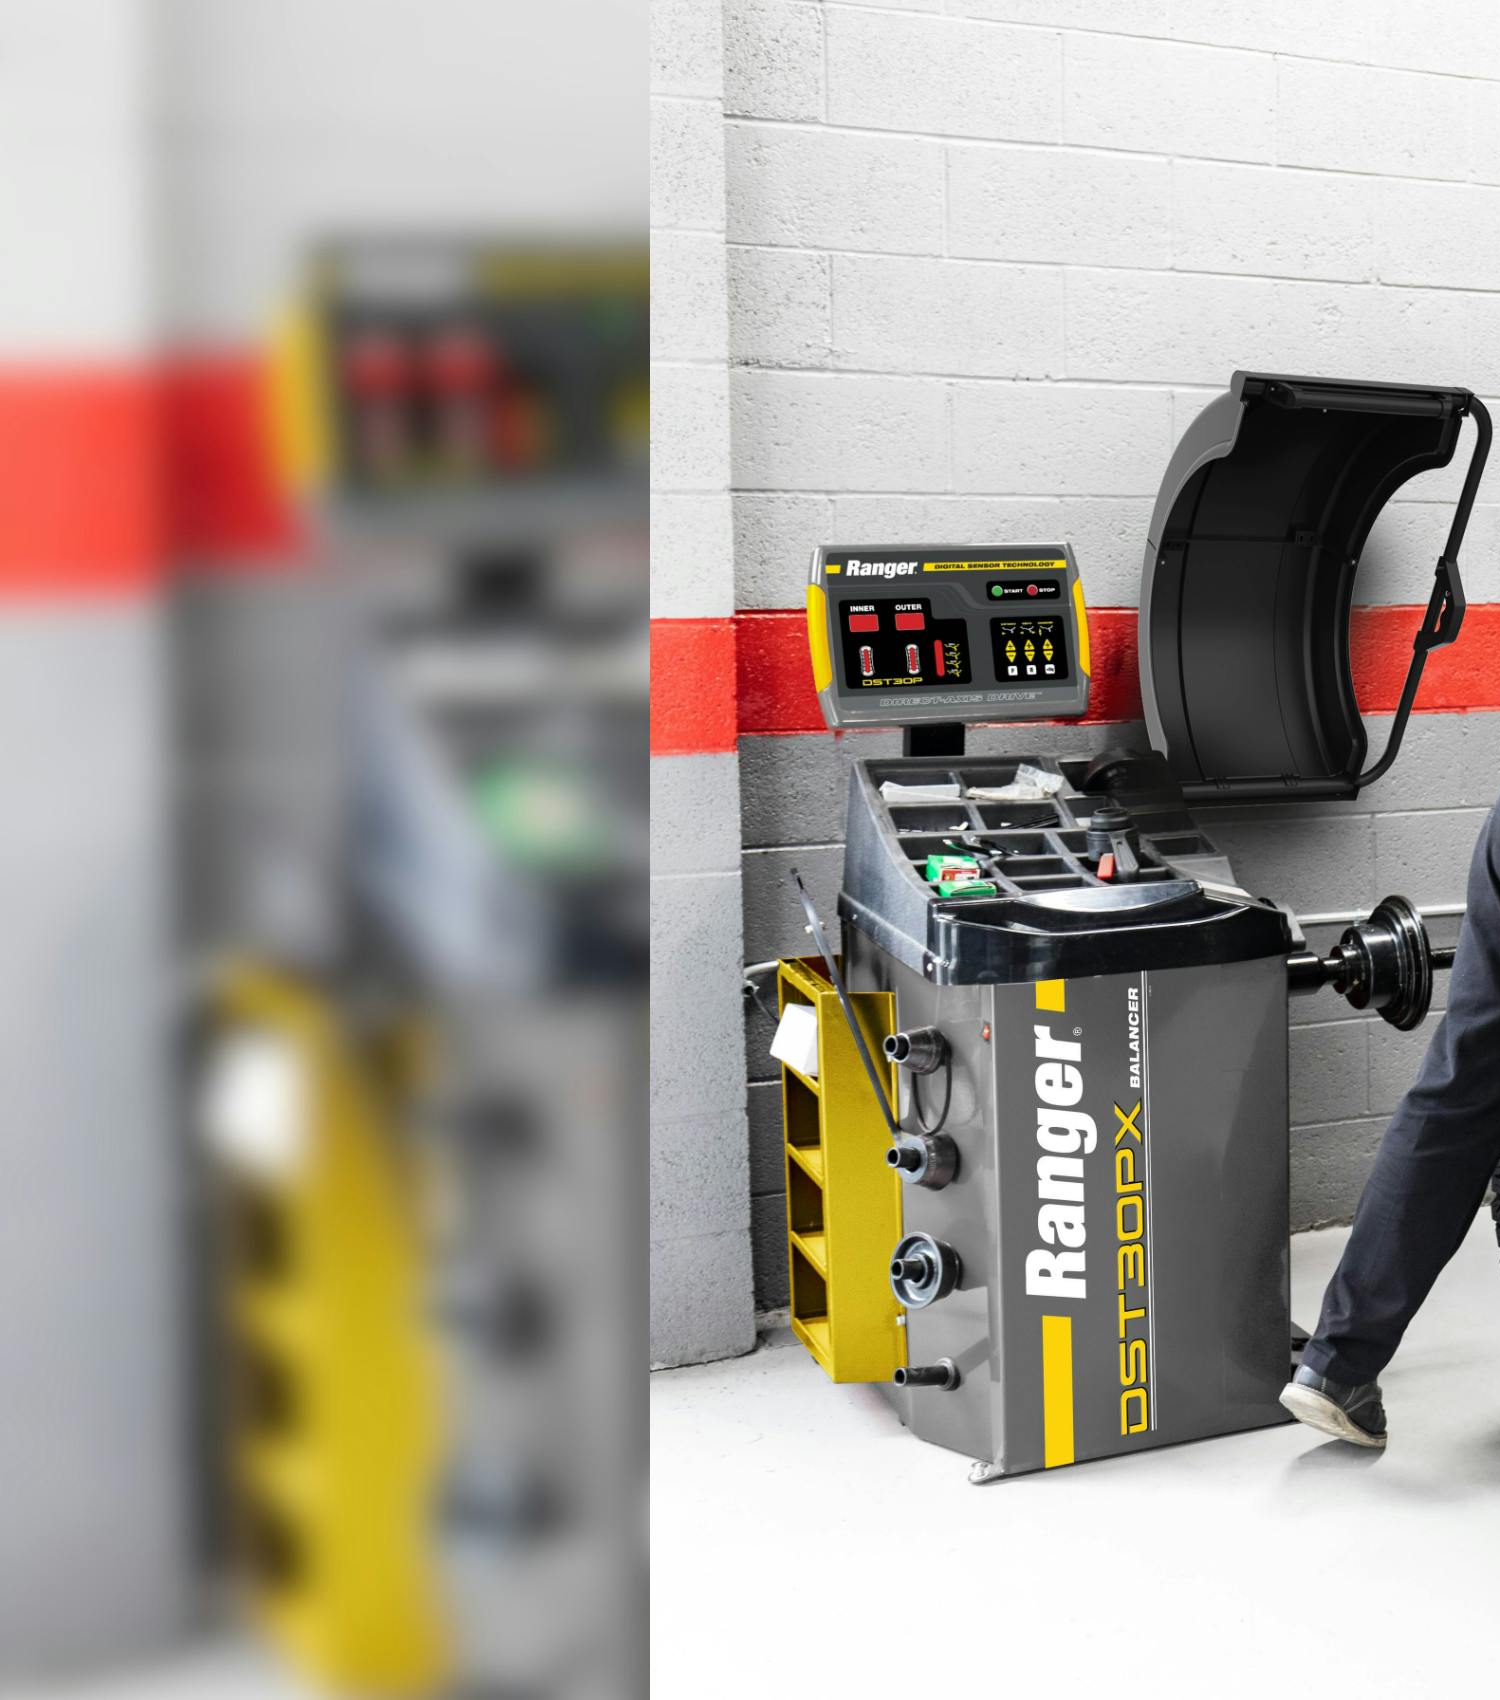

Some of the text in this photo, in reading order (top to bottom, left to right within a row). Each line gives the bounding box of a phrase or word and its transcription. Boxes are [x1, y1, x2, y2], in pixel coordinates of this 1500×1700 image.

[846, 560, 918, 579] Ranger
[895, 603, 922, 611] OUTER
[862, 677, 923, 687] DST30P
[1025, 1024, 1097, 1300] Ranger
[1114, 987, 1150, 1436] DST30PX BALANCER
